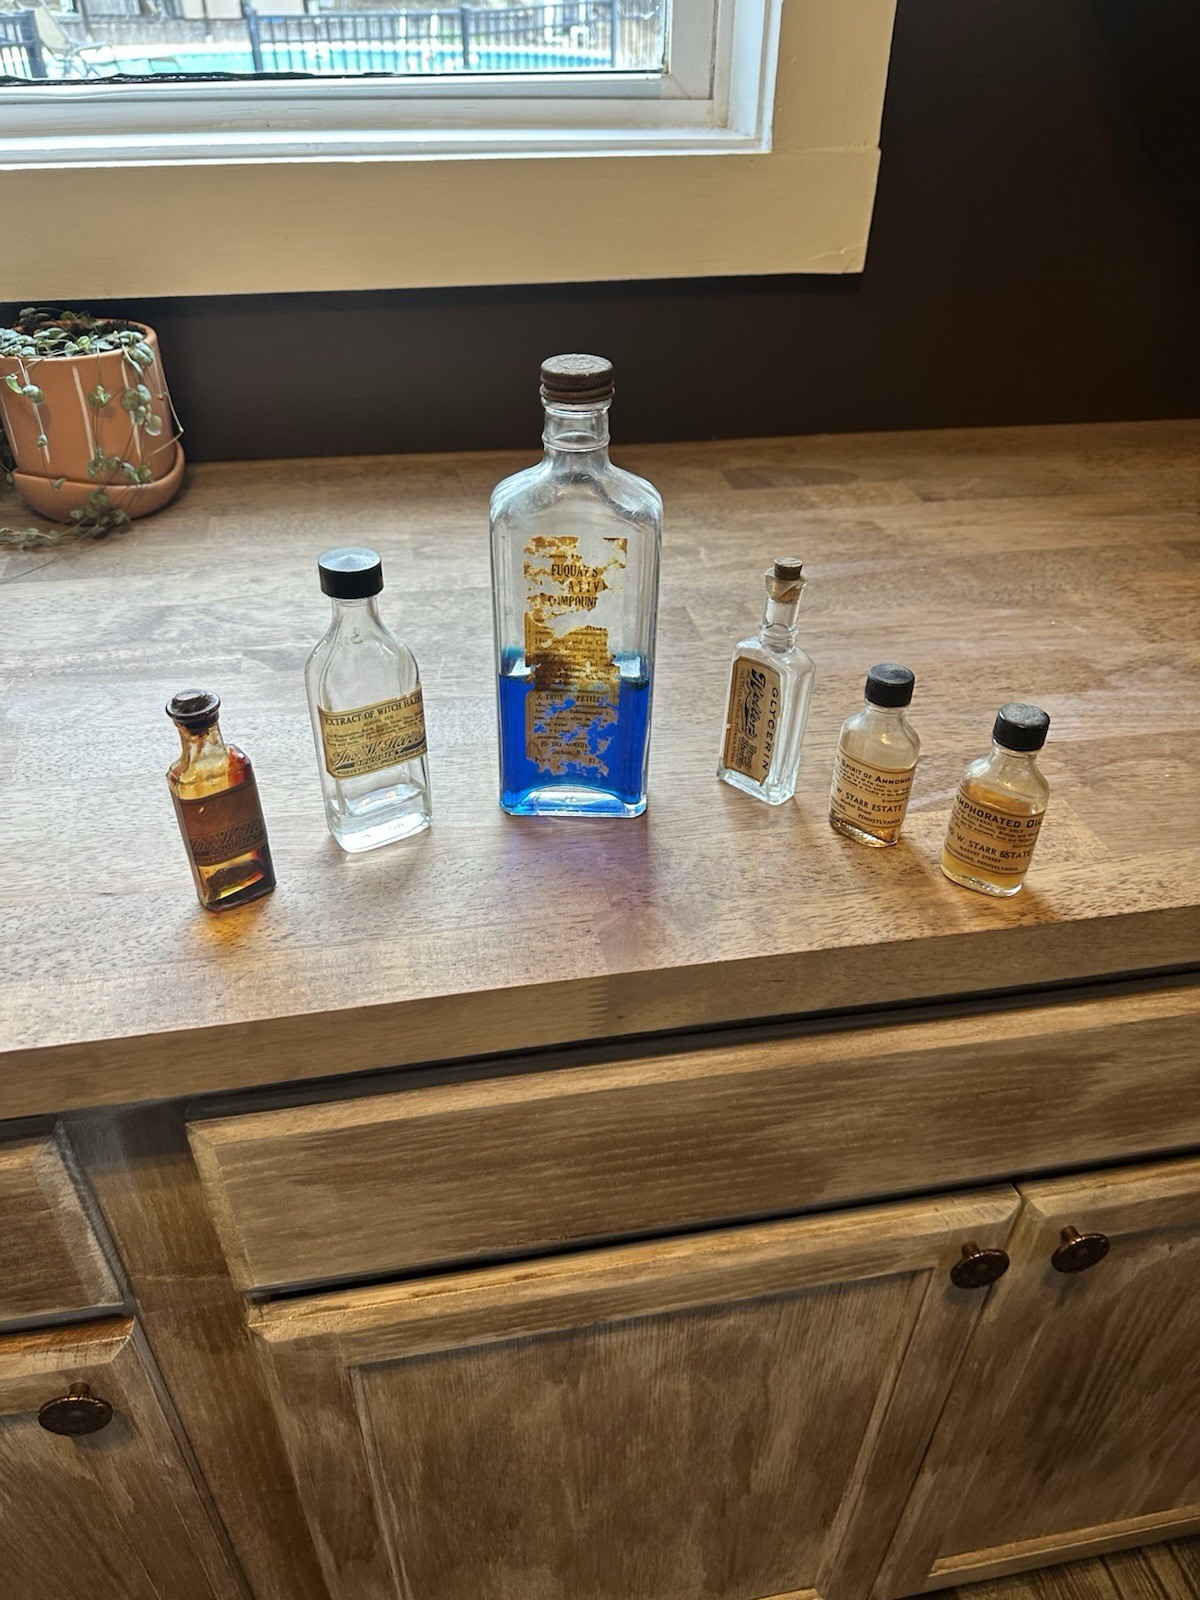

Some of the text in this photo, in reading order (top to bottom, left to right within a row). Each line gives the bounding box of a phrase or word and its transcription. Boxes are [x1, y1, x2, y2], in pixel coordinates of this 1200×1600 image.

[325, 714, 362, 726] EXTRACT
[364, 710, 375, 719] OF
[377, 702, 402, 715] WITCH
[403, 696, 422, 708] HAZE
[762, 687, 779, 770] GLYCERIN
[737, 736, 749, 769] Store
[745, 743, 757, 771] Drug
[840, 798, 872, 816] Market Street
[845, 792, 869, 808] STARR
[872, 803, 903, 813] ESTATE
[957, 795, 1021, 828] AMPHORATED
[857, 813, 901, 825] PENNSYLVANIA
[956, 833, 966, 845] W.
[968, 840, 997, 856] STARR
[999, 849, 1031, 859] ESTATE
[959, 845, 1001, 863] MARKET STREET
[977, 860, 1018, 871] PENNSYLVANIA
